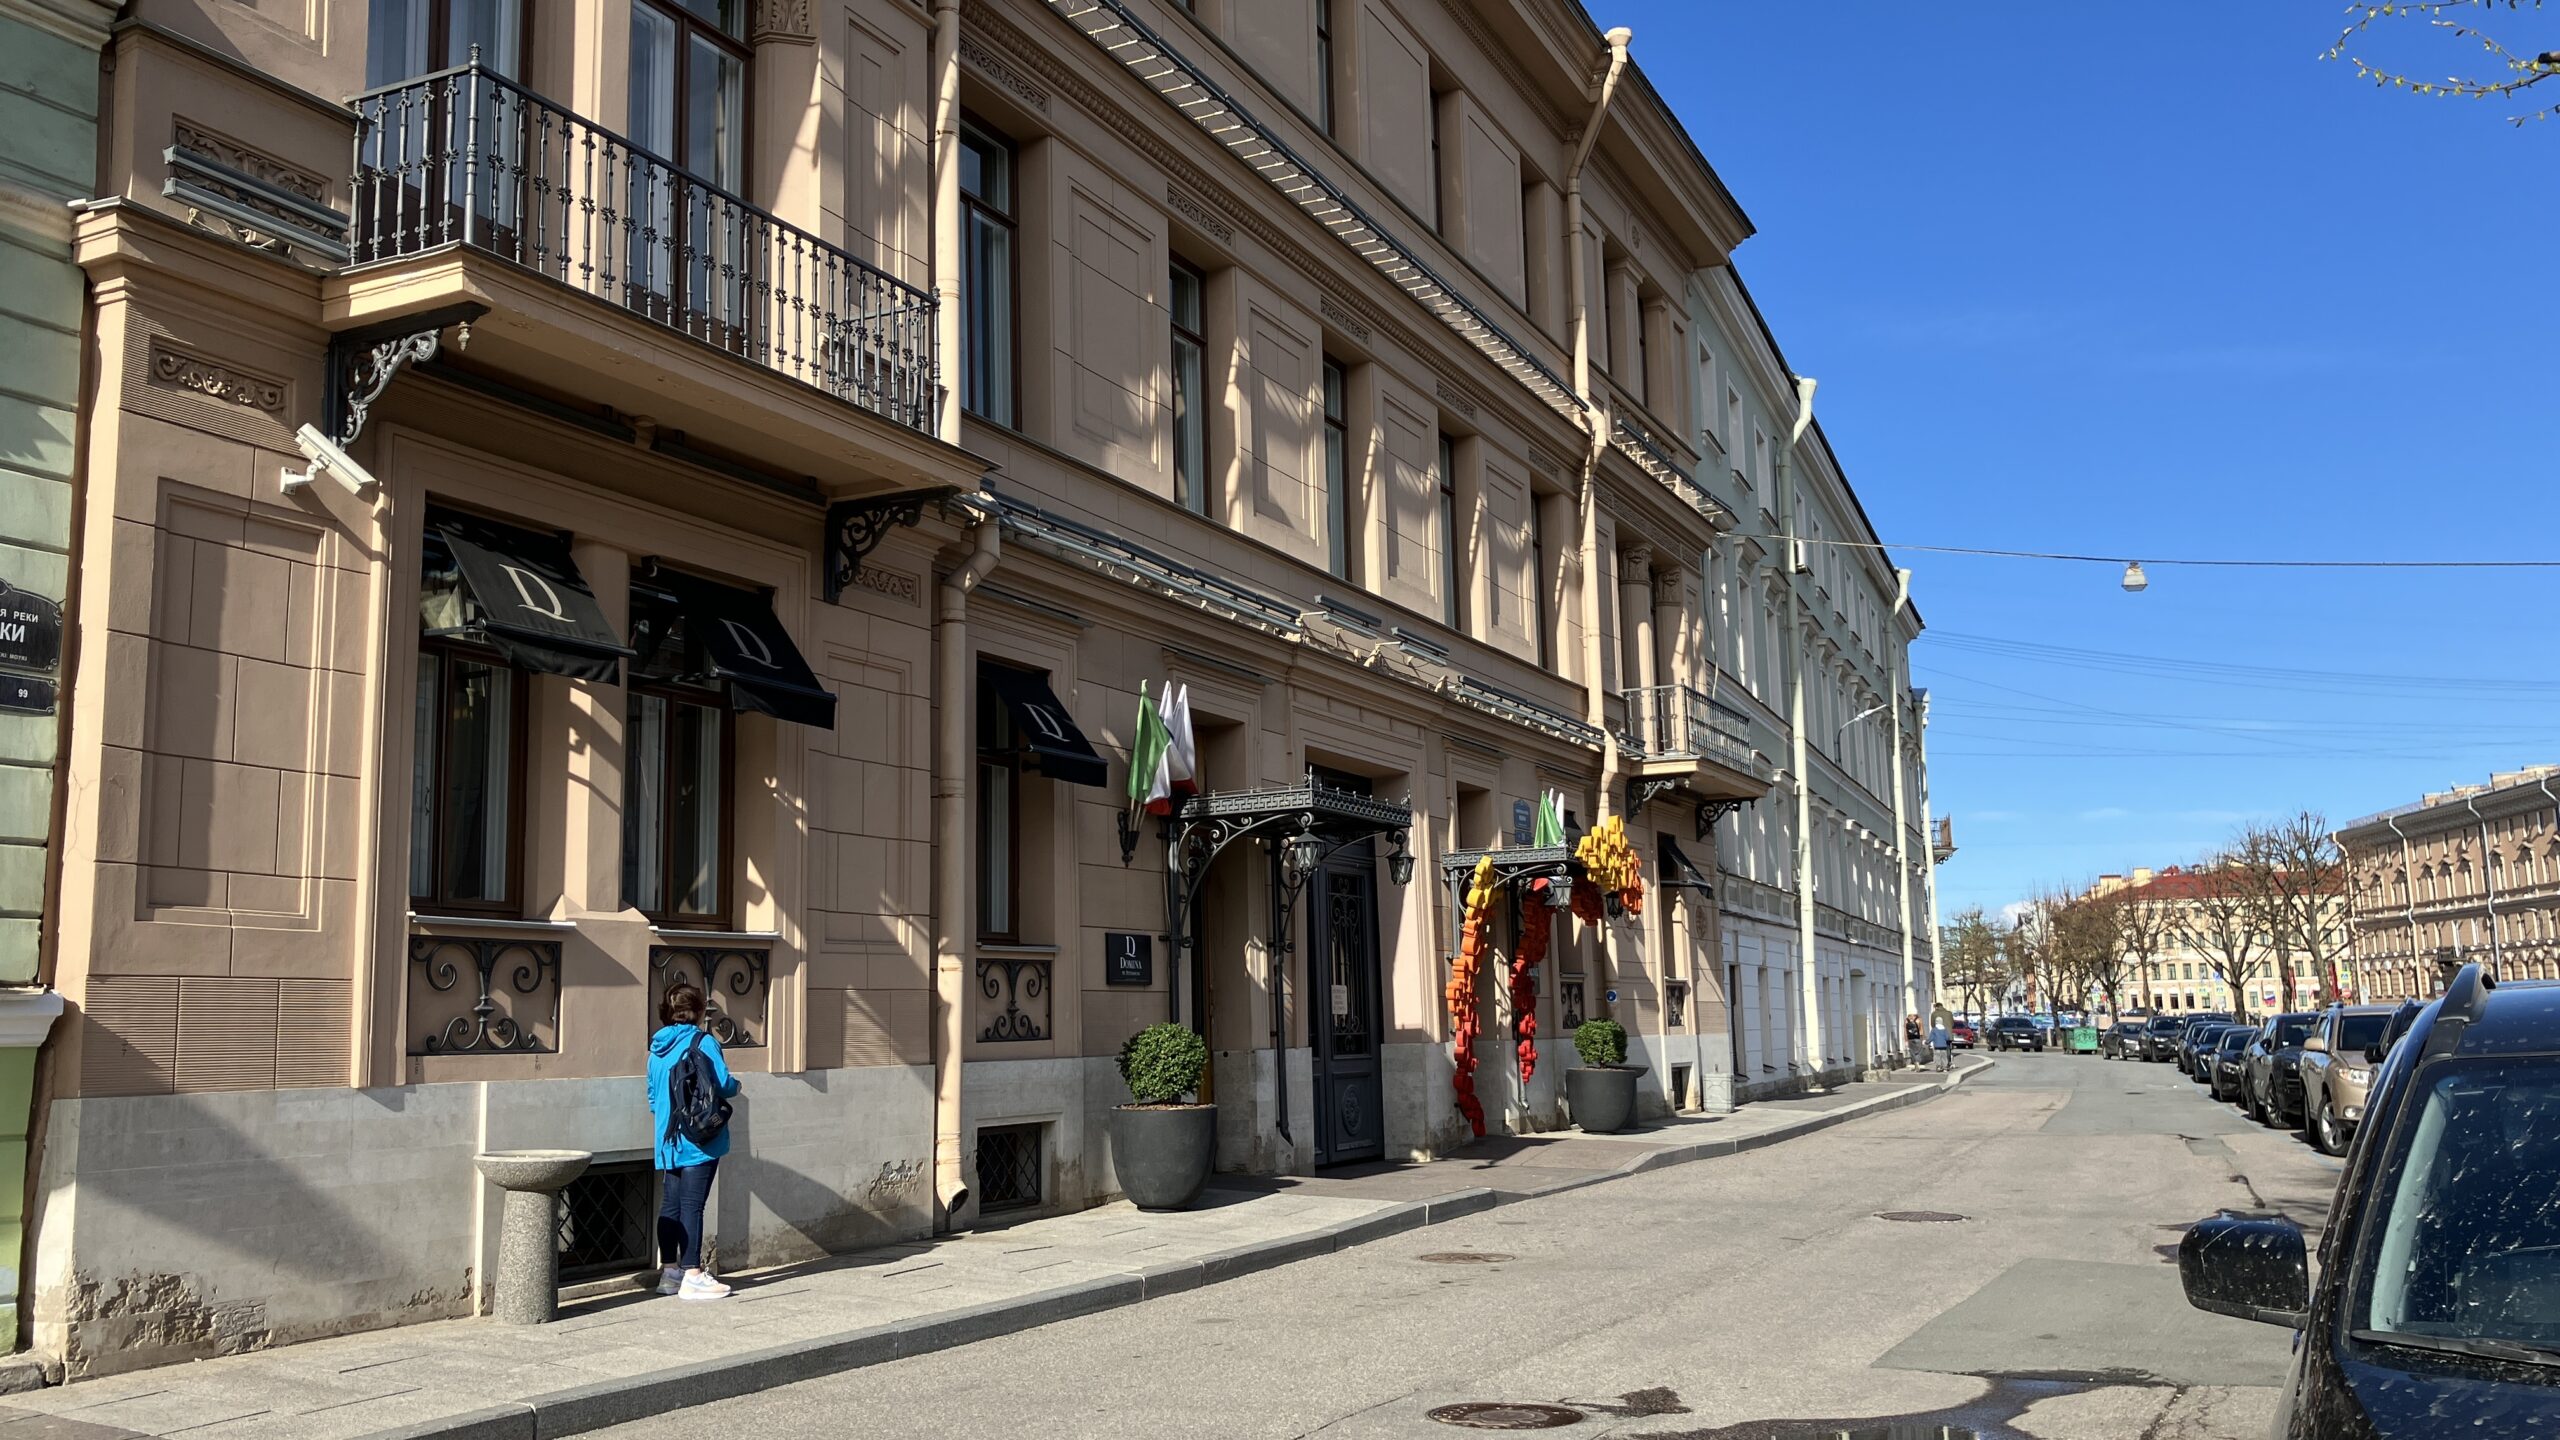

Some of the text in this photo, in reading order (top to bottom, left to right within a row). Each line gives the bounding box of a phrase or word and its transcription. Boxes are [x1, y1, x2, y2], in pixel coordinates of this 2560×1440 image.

[498, 563, 576, 623] D
[13, 611, 39, 623] РЕКИ
[0, 621, 25, 643] КИ
[718, 618, 784, 669] D
[18, 688, 29, 698] 99
[1021, 702, 1071, 742] D
[1125, 935, 1137, 958] D
